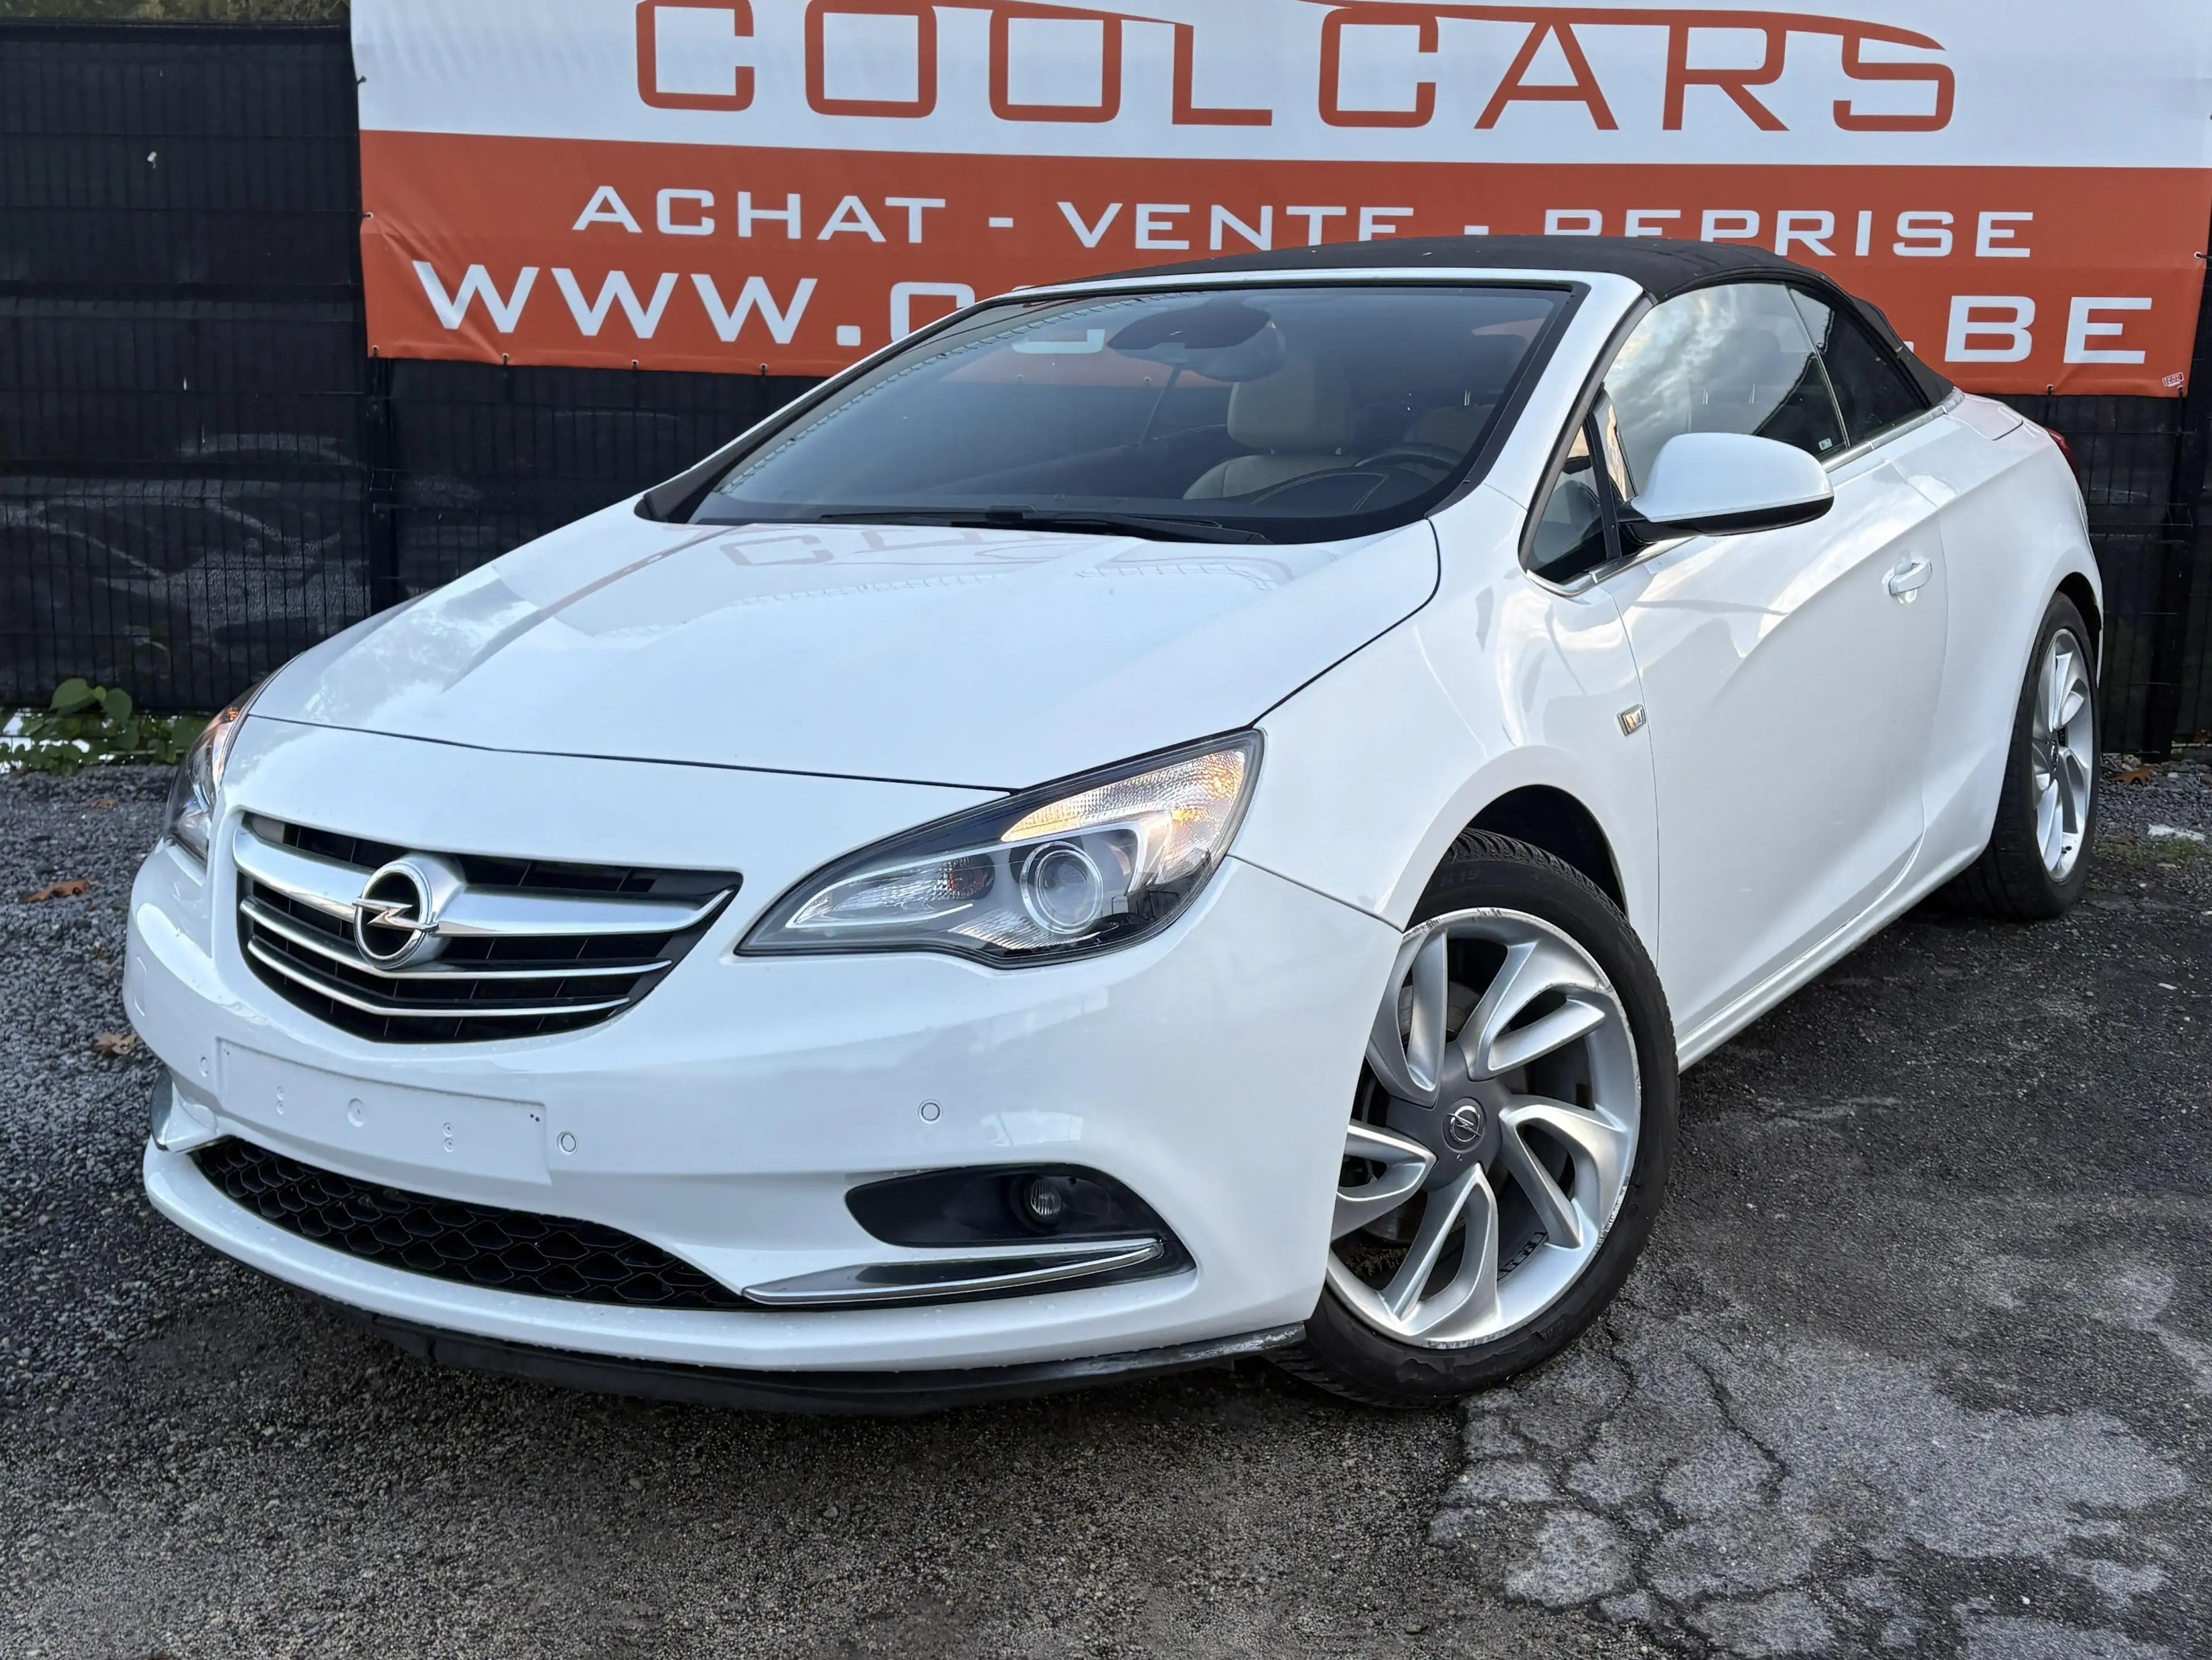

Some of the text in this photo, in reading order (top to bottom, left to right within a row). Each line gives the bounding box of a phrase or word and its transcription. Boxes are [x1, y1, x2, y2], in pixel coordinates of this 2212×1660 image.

[636, 0, 1956, 132] COOLCARS
[572, 185, 946, 244] ACHAT
[1056, 201, 1415, 252] VENTE
